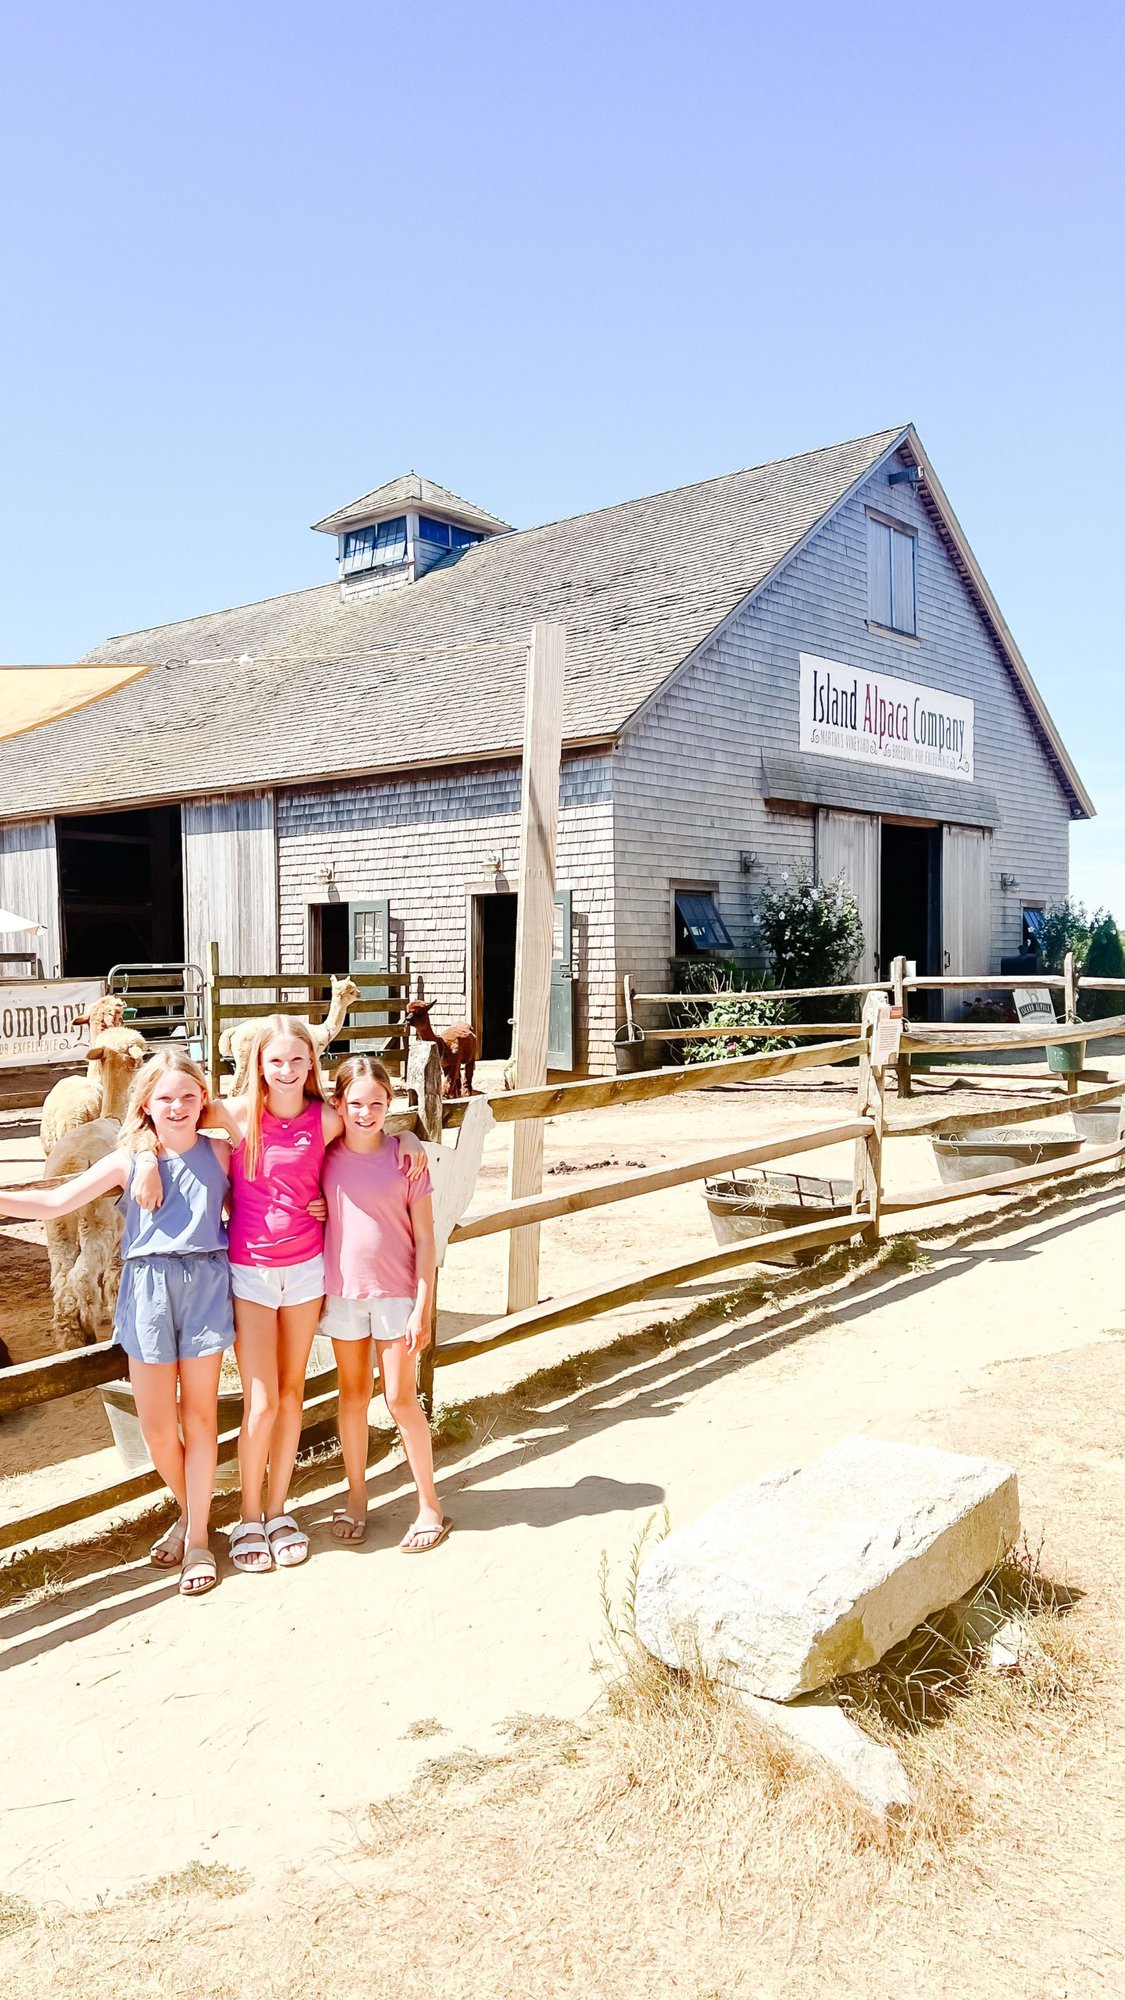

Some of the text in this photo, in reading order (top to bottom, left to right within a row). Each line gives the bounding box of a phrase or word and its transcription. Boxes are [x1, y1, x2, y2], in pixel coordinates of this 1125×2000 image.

[812, 670, 965, 762] Island Alpaca Company
[845, 735, 870, 753] VINEYARD
[892, 744, 950, 768] BREEDING FOR EXCELLENCE
[0, 1003, 86, 1045] ompany
[0, 1039, 58, 1055] OR EXCELLENCE
